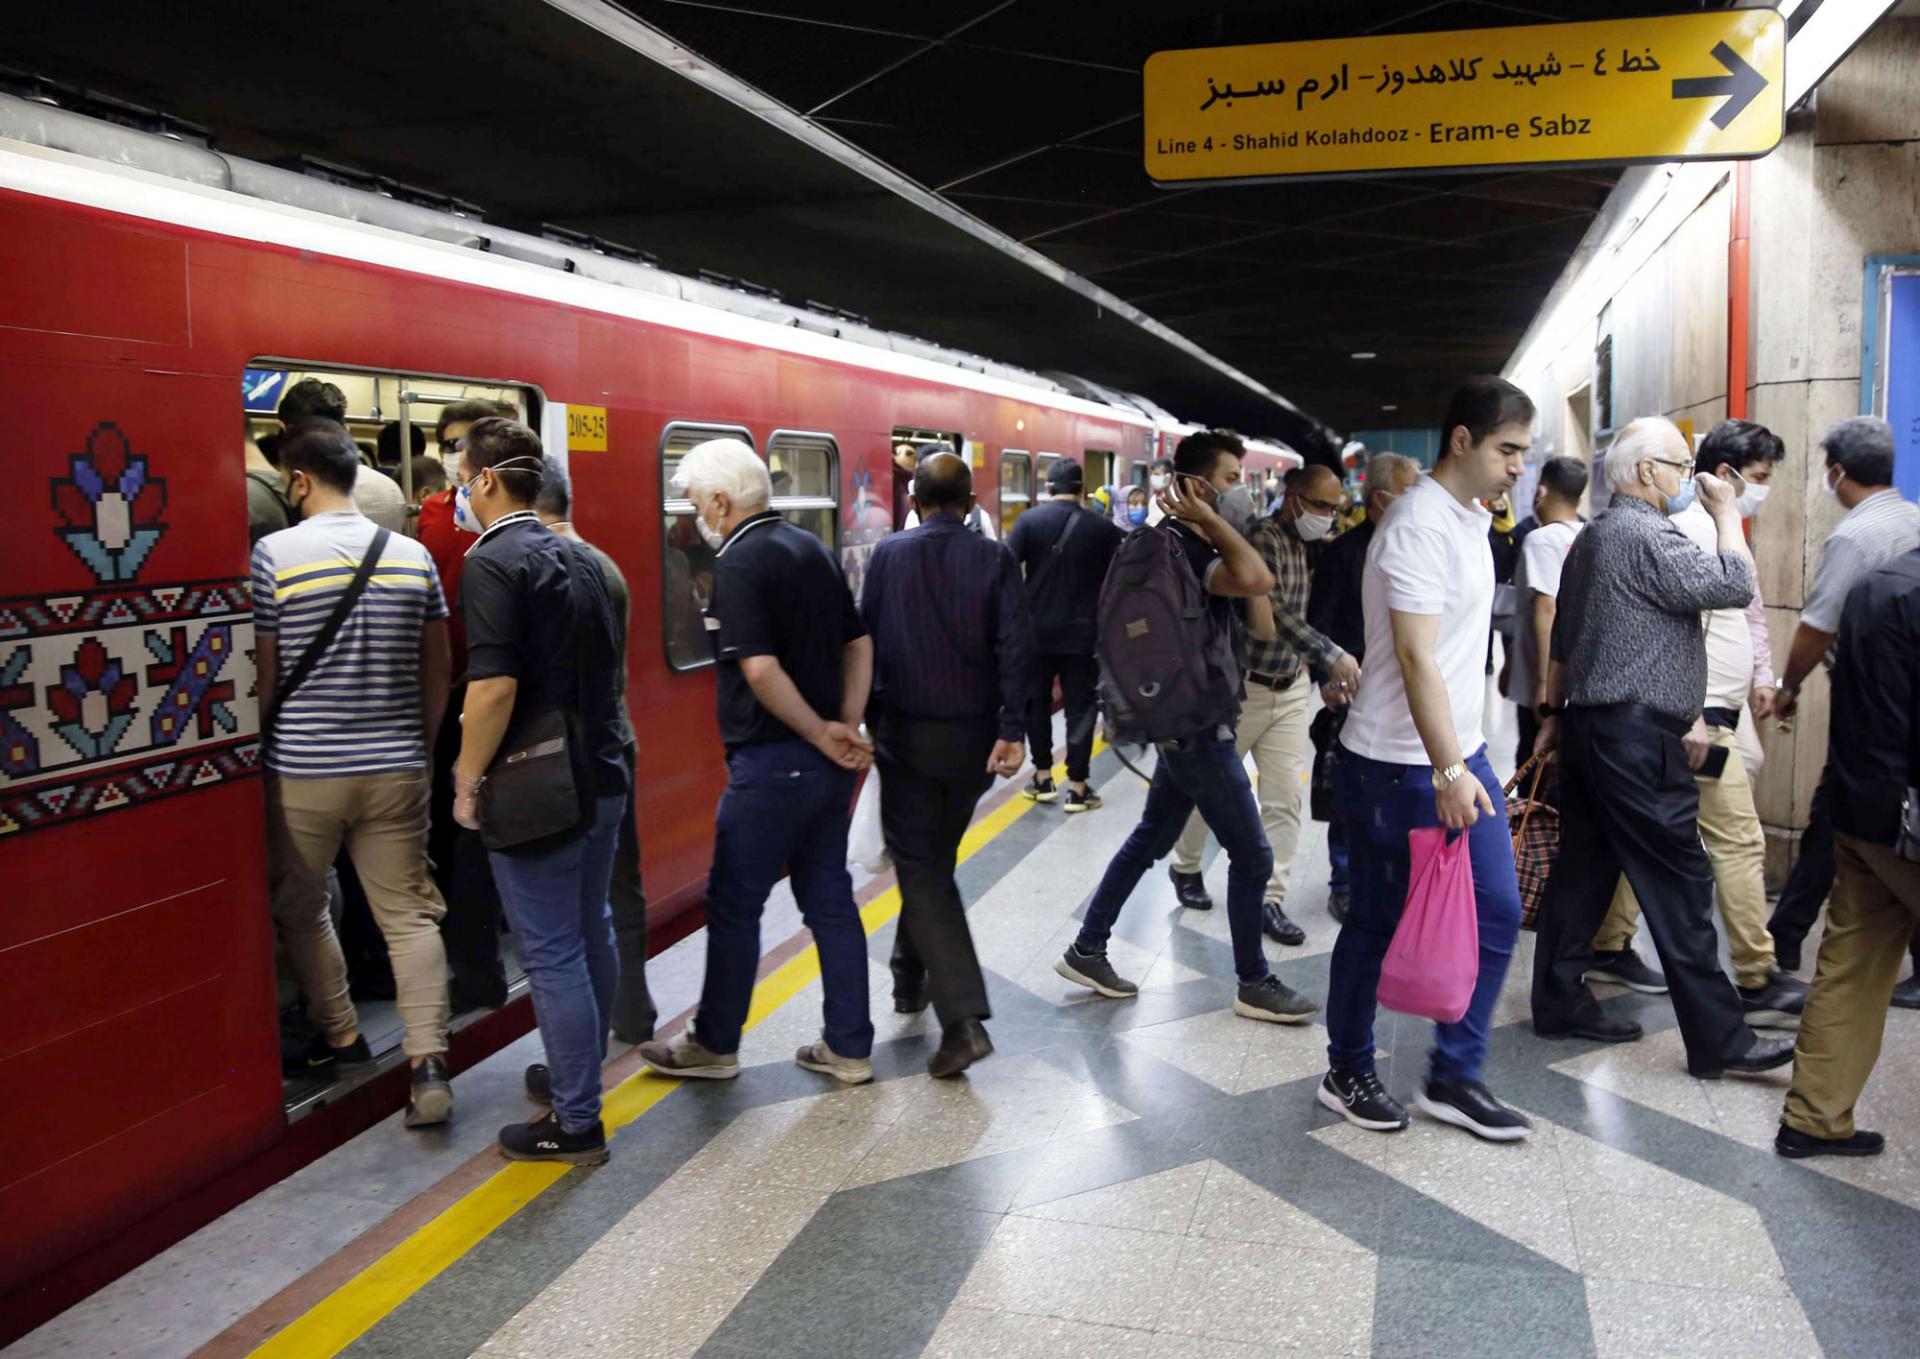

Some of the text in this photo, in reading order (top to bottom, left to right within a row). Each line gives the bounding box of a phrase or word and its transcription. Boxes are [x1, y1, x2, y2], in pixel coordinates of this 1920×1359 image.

[1492, 52, 1562, 87] شهید
[1617, 48, 1662, 73] خط
[1199, 77, 1286, 112] سبز
[1296, 63, 1349, 112] ارم
[1157, 138, 1197, 155] Line
[1203, 135, 1214, 152] 4
[1232, 132, 1299, 151] Shahid
[1305, 128, 1409, 146] Kolahdooz
[1429, 122, 1520, 144] Eram-e
[1529, 112, 1592, 138] Sabz
[569, 413, 605, 439] 205-25
